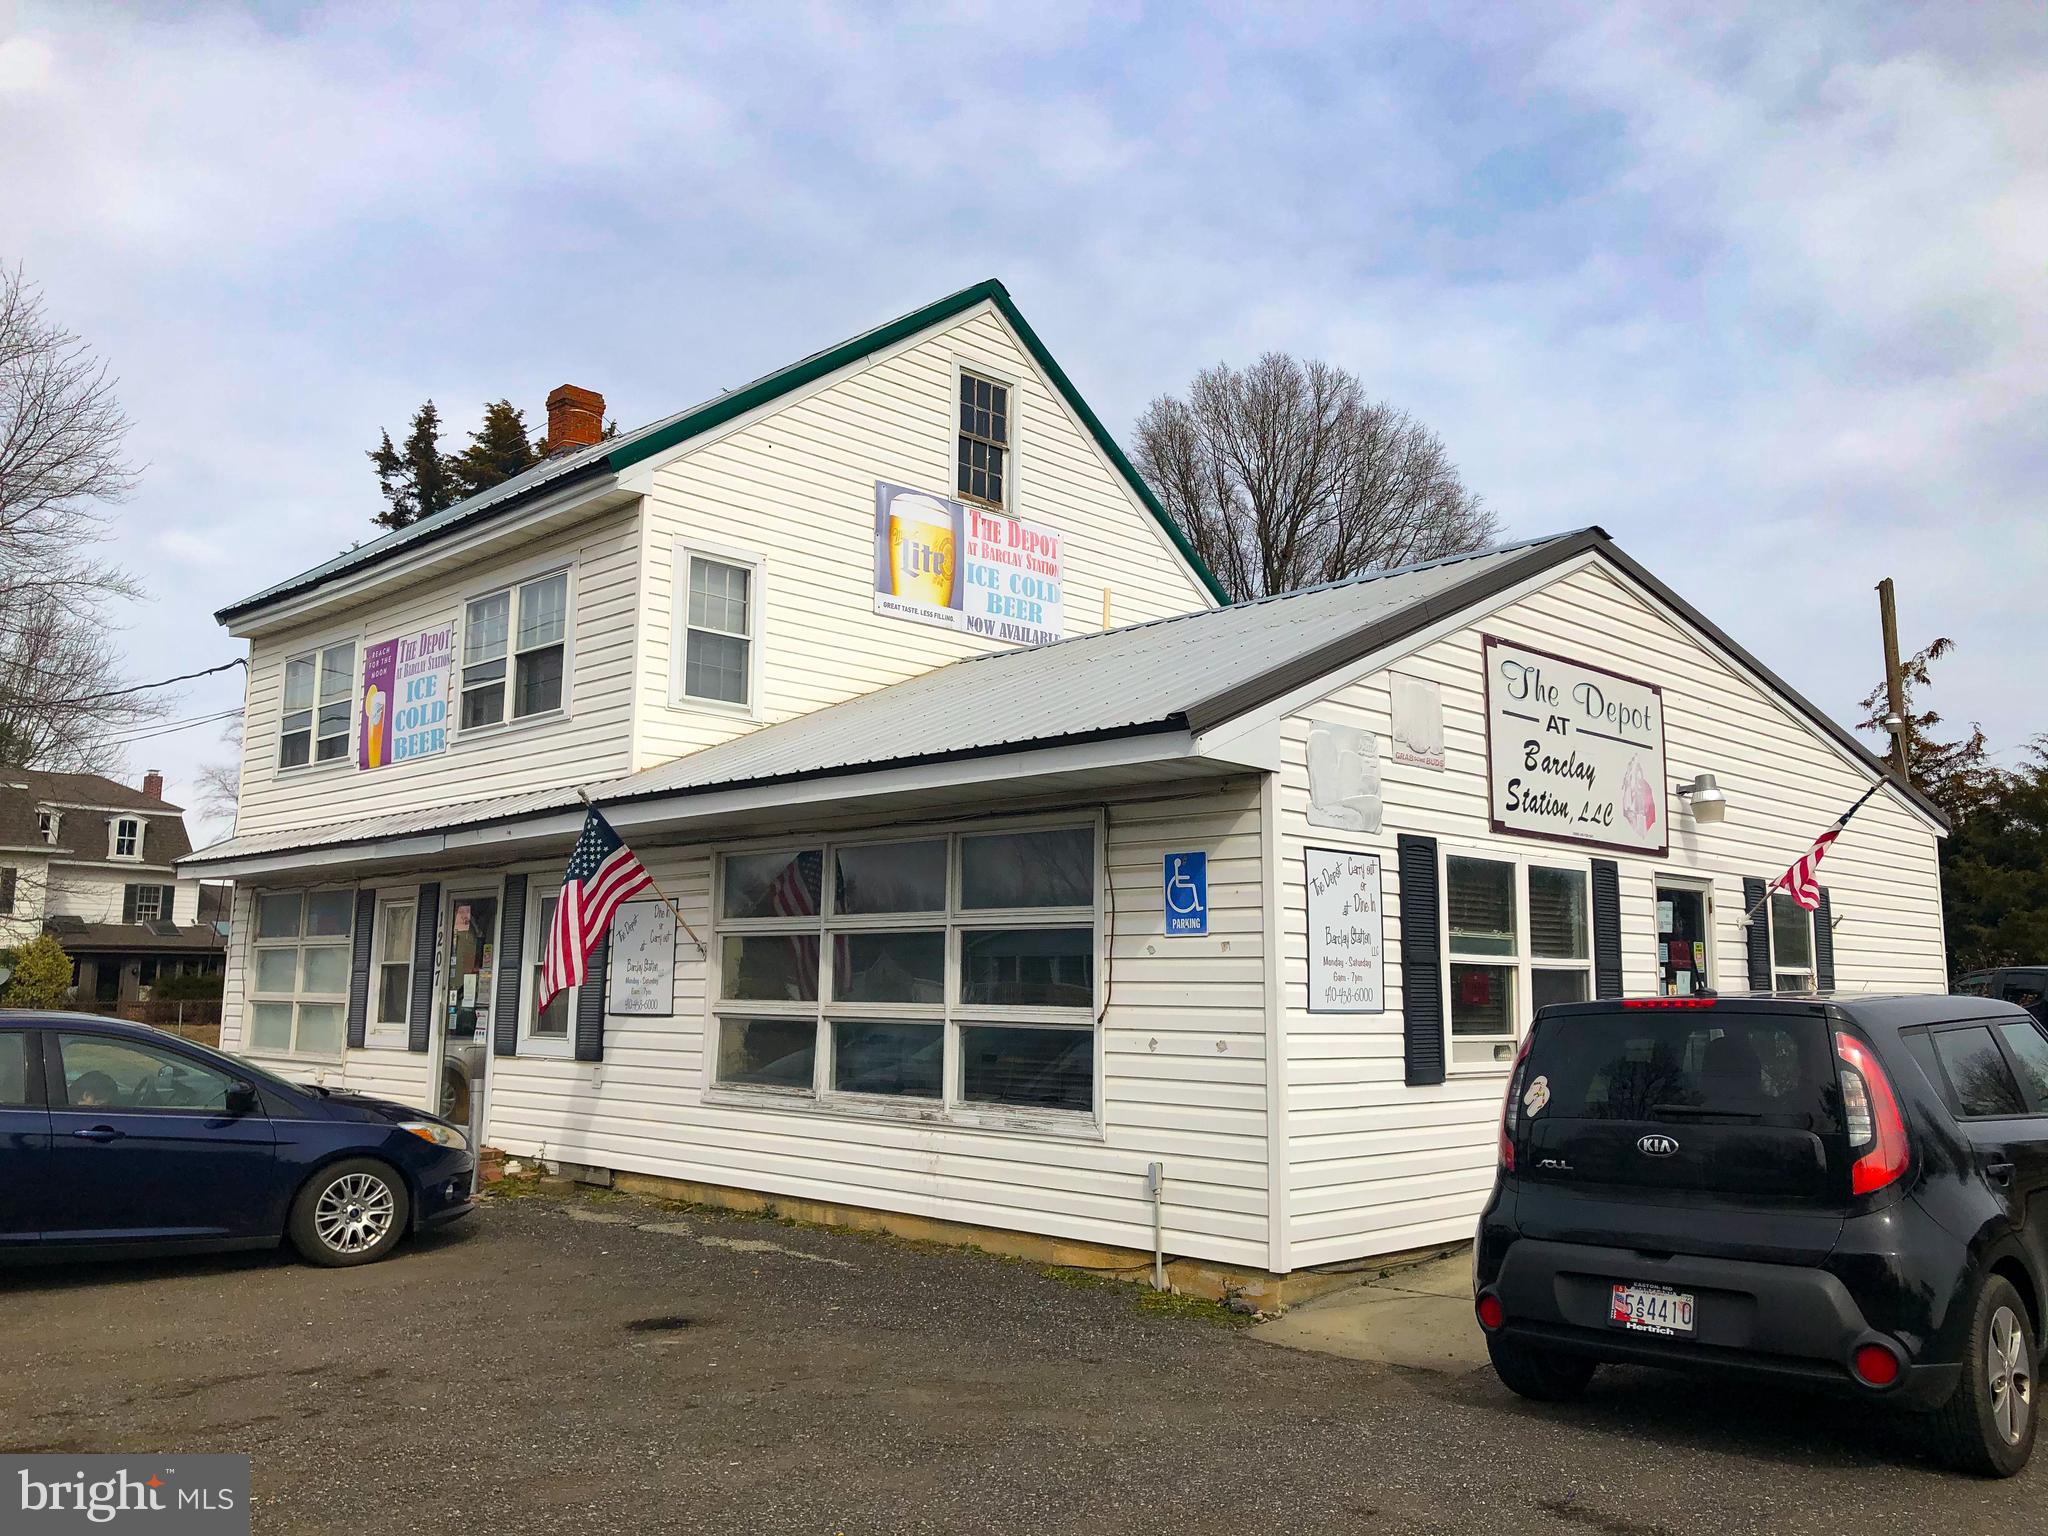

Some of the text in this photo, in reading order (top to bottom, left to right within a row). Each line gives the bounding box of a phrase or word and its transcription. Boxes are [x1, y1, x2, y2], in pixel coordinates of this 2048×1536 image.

[969, 509, 1058, 560] THE DEPOT
[901, 539, 945, 578] Lite
[967, 541, 1060, 578] AT BARCLAY STATION
[966, 562, 1000, 590] ICE
[1009, 573, 1061, 604] COLD
[883, 601, 901, 611] GREAT
[920, 608, 933, 618] LESS
[986, 592, 1042, 624] BEER
[966, 615, 996, 635] NOW
[400, 629, 451, 664] THE DEPOT
[381, 655, 392, 665] THE
[406, 674, 437, 703] ICE
[1500, 660, 1653, 734] The Depot
[395, 700, 446, 732] COLD
[1545, 715, 1570, 736] AT
[393, 727, 445, 761] BEER
[1426, 757, 1445, 768] BUDS
[1523, 739, 1596, 791] Barclay
[1505, 778, 1614, 827] Station, LLC
[1309, 861, 1343, 896] The Depot
[1347, 856, 1378, 880] Carry out
[1360, 881, 1367, 892] or
[1342, 900, 1352, 916] at
[1353, 893, 1377, 912] Dine In
[1172, 918, 1201, 929] PARKING
[434, 911, 443, 987] 1207
[1325, 925, 1372, 949] Barclay Station
[1323, 956, 1344, 968] Monday
[1348, 956, 1372, 968] Saturday
[1333, 971, 1346, 982] 6am
[1351, 971, 1363, 984] 7pm
[1325, 986, 1374, 1005] 410-438-6000
[1643, 1138, 1672, 1153] KIA
[1535, 1159, 1574, 1170] SOUL
[1626, 1322, 1674, 1335] Hertrich
